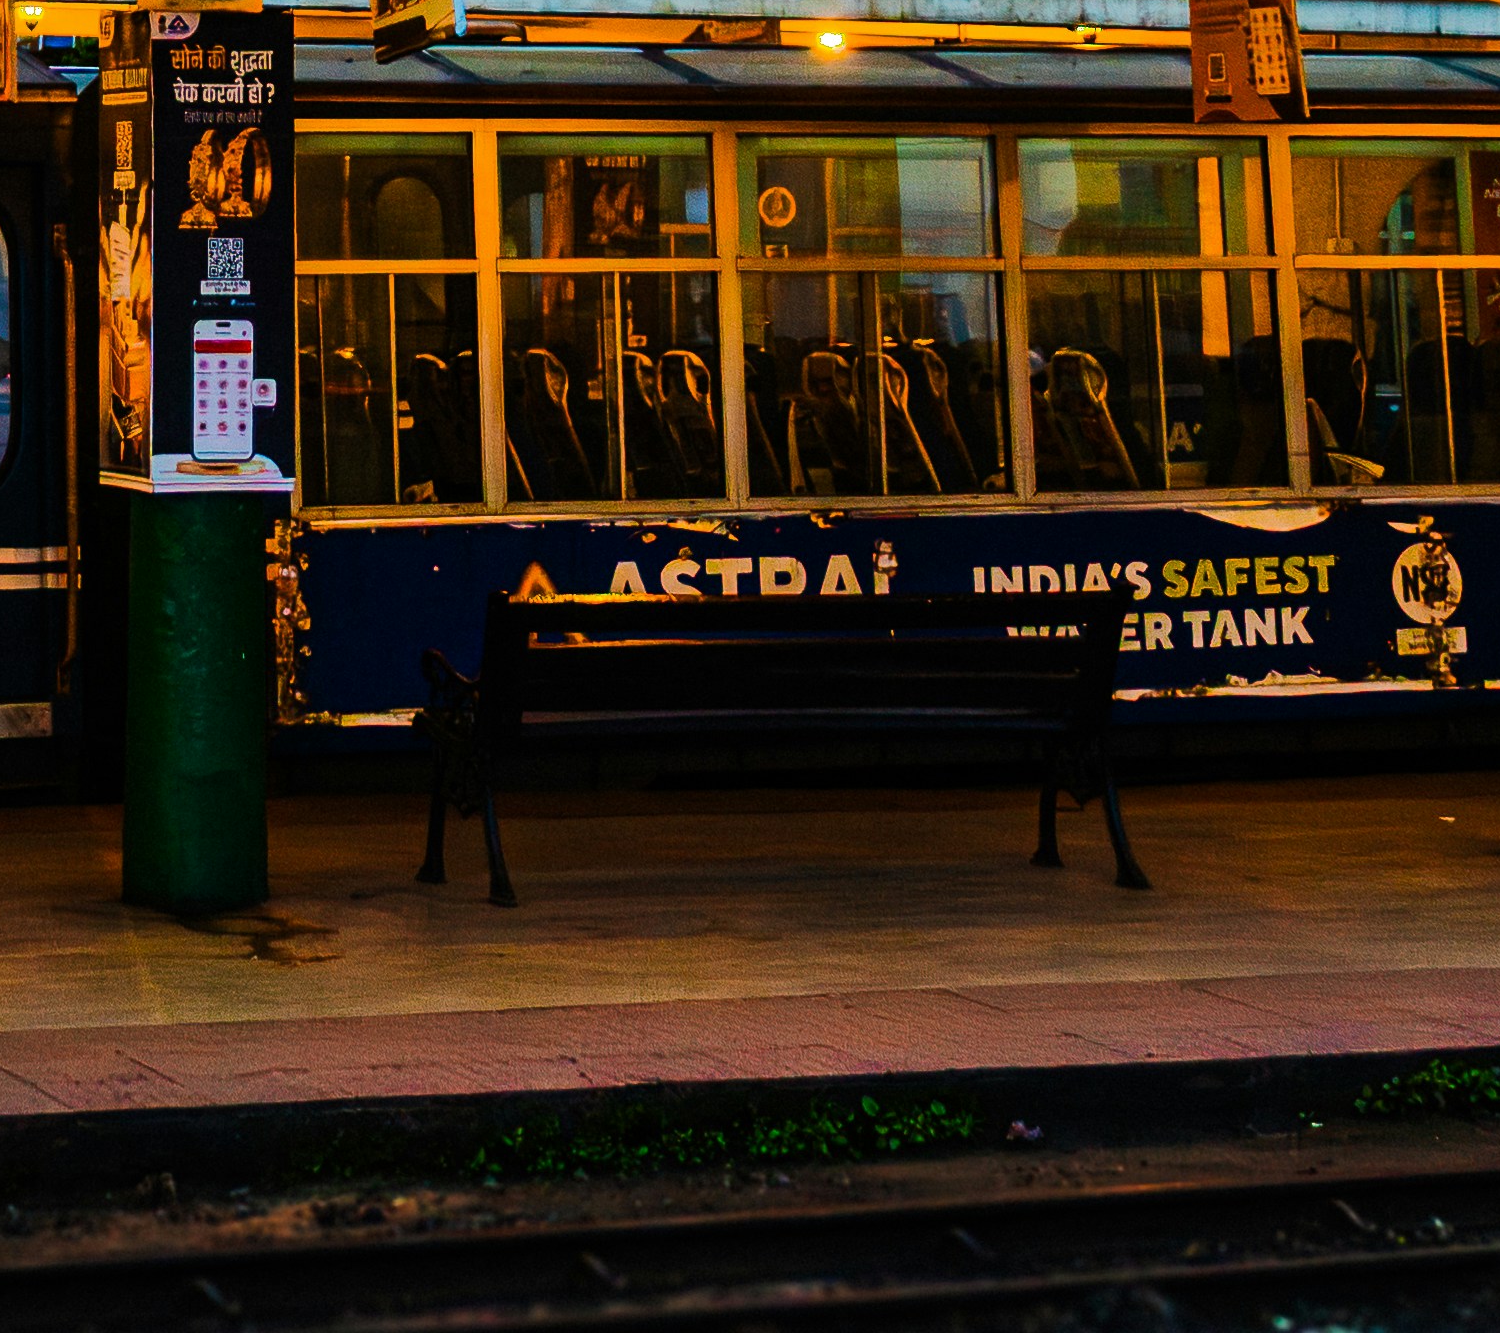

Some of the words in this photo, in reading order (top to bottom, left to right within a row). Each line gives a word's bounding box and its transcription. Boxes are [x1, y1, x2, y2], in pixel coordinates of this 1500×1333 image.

[170, 44, 203, 69] सोने
[207, 45, 225, 69] की
[231, 50, 273, 76] शुद्धता
[173, 76, 199, 103] चेक
[201, 77, 244, 104] करनी
[247, 77, 263, 103] हो
[973, 561, 1152, 600] INDIA'S
[1162, 555, 1335, 598] SAFEST
[1183, 606, 1314, 648] TANK
